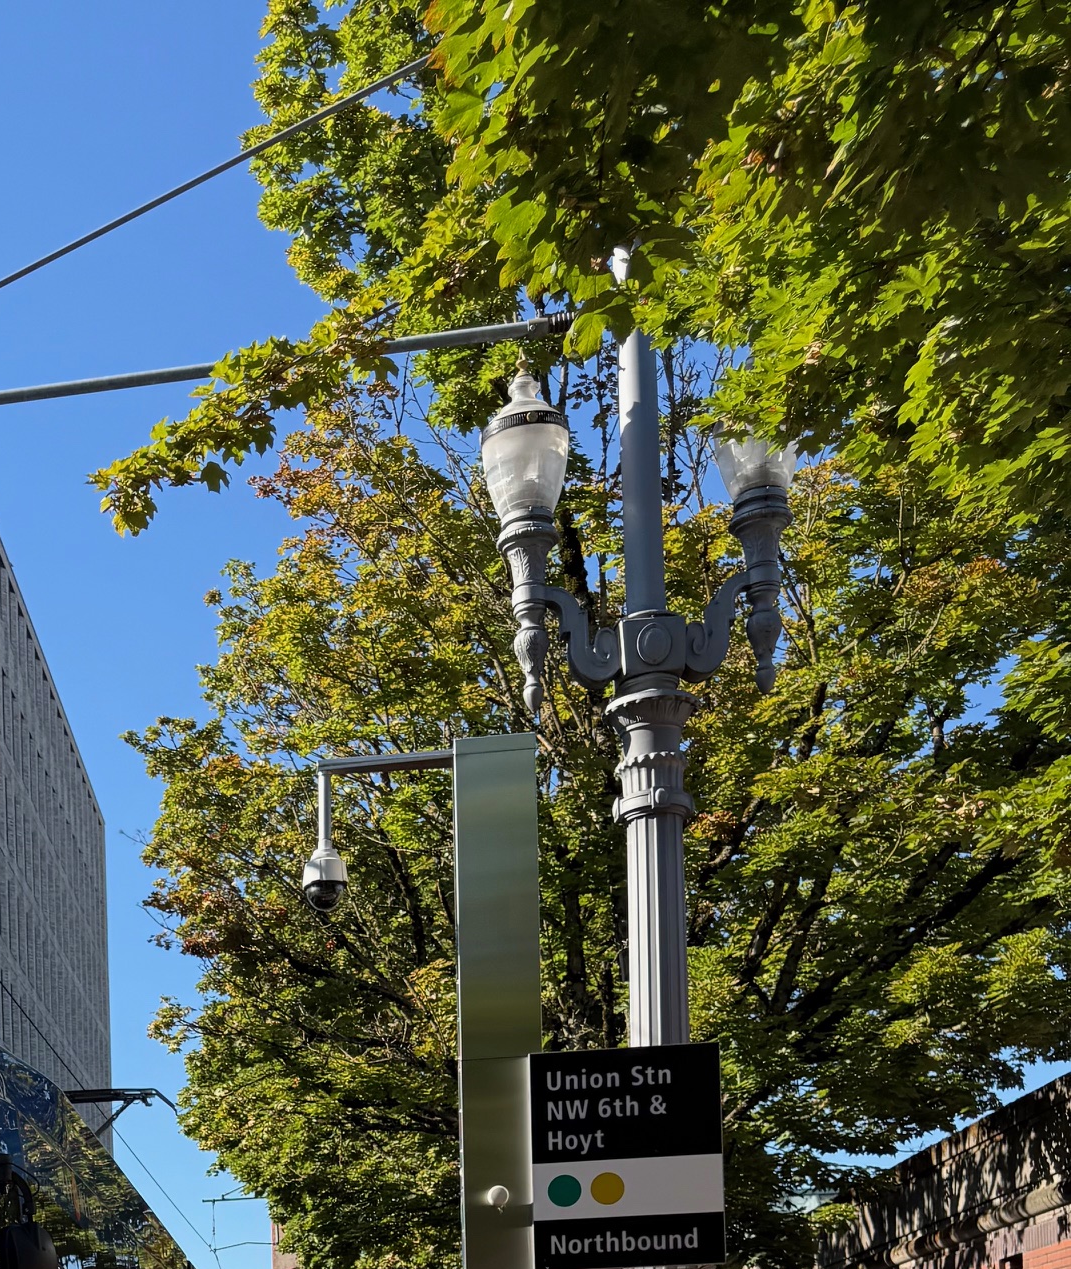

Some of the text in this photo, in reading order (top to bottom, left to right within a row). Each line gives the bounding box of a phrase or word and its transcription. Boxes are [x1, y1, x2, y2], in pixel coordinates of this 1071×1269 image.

[547, 1066, 671, 1091] Union Stn
[547, 1095, 667, 1121] NW 6th &
[548, 1130, 604, 1154] Hoyt
[550, 1228, 698, 1254] Northbound
